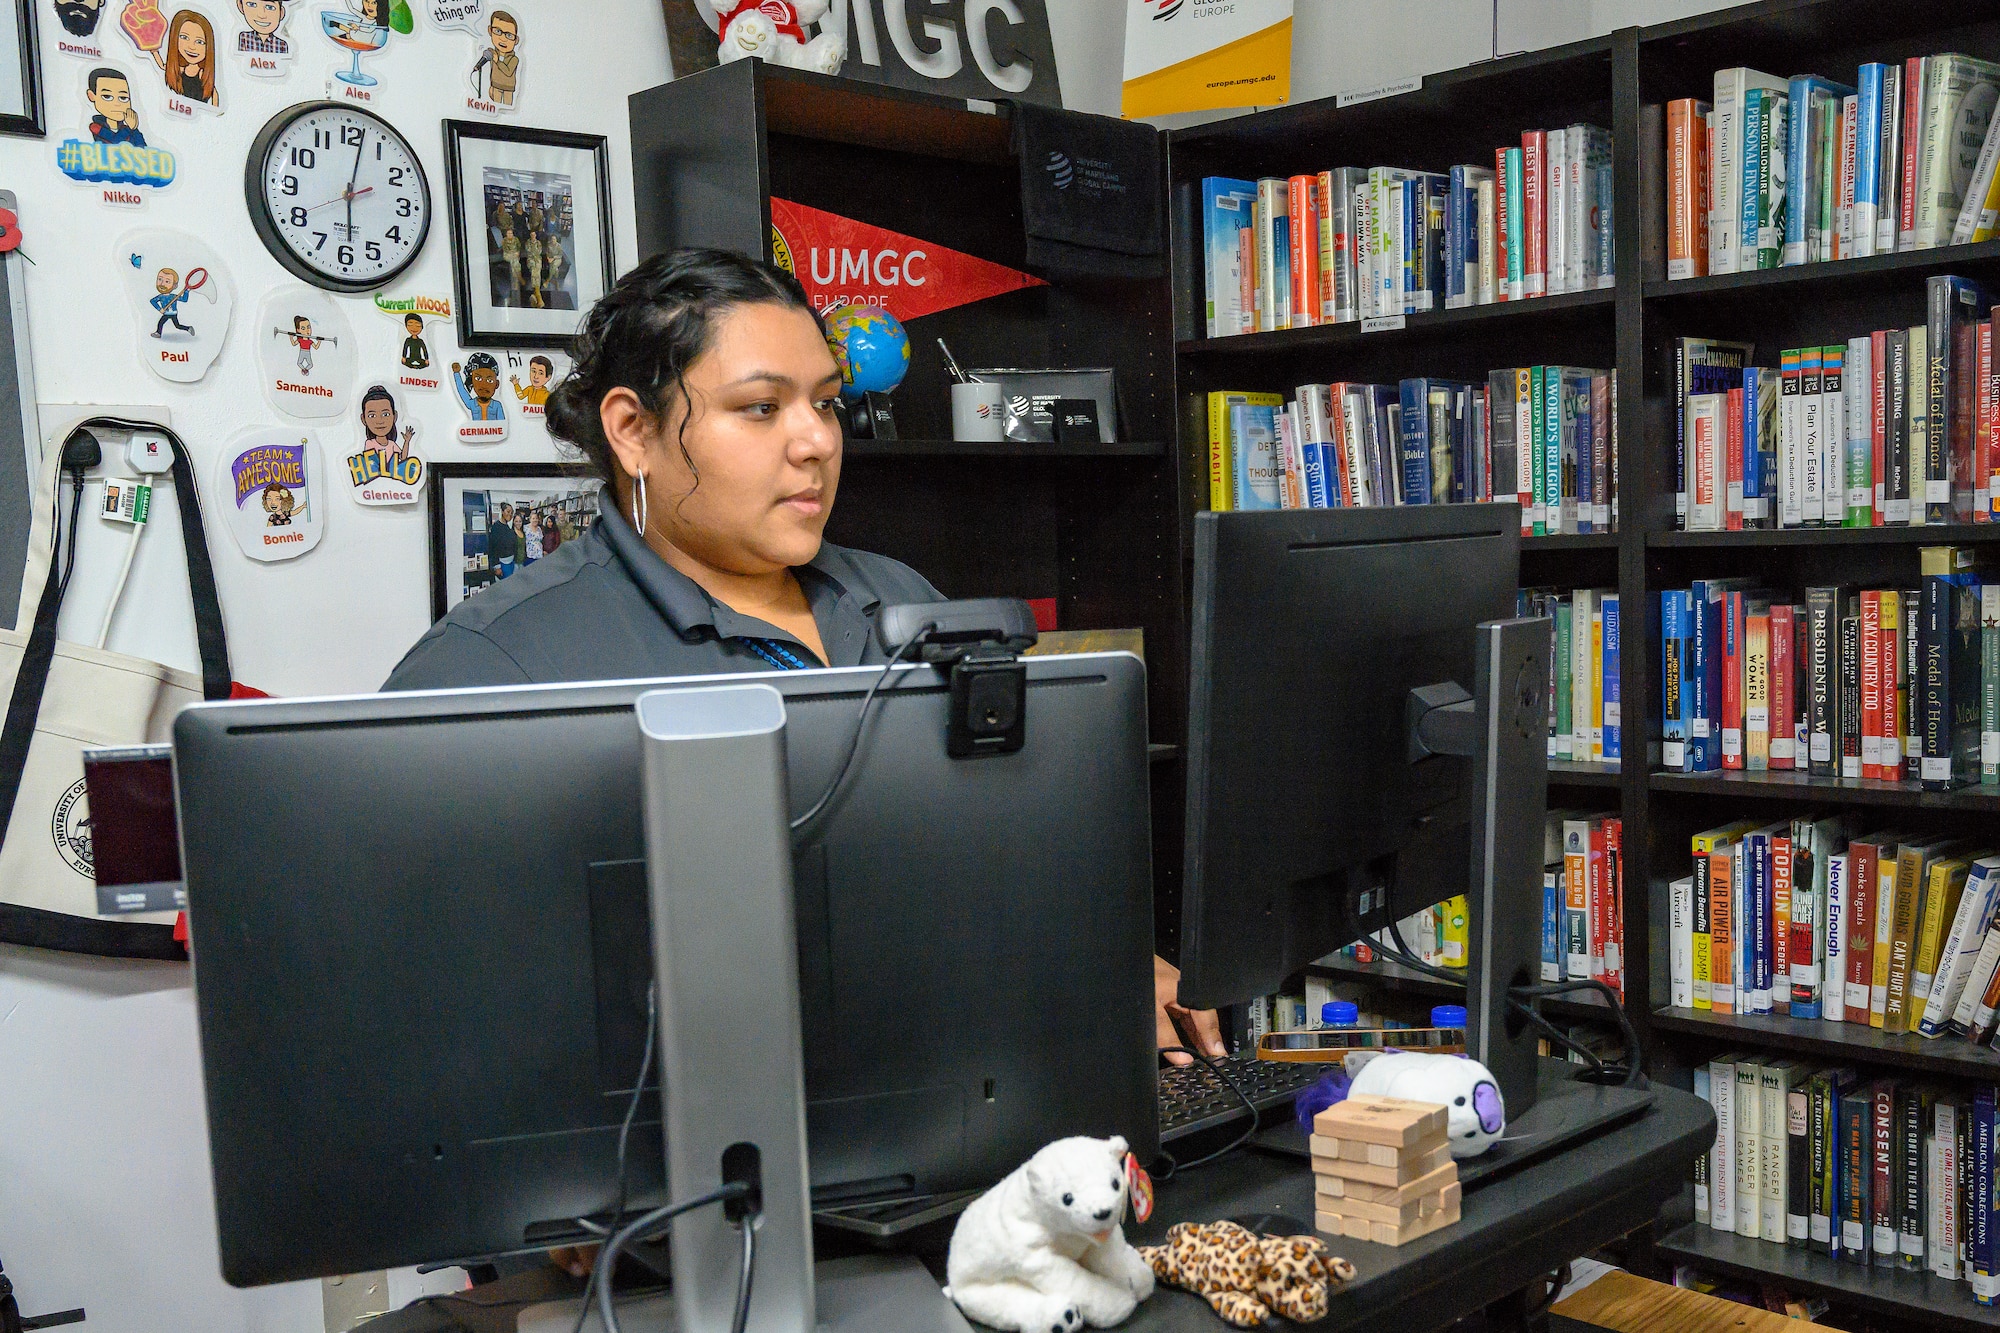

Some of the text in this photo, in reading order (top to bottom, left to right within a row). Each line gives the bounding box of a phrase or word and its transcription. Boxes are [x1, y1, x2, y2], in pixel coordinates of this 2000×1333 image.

[434, 8, 464, 20] thing
[1194, 5, 1235, 18] EUROPE
[59, 42, 101, 57] Dominic
[250, 58, 276, 70] Alex
[1206, 75, 1275, 88] europe.umgc.edu
[1355, 89, 1381, 99] Philosophy
[1387, 82, 1414, 93] Psychology
[346, 87, 370, 101] Alee
[169, 99, 192, 115] Lisa
[467, 97, 495, 114] Kevin
[1883, 78, 1894, 138] Redemption
[314, 129, 330, 149] 11
[340, 126, 362, 145] 12
[1849, 126, 1855, 135] A
[60, 144, 174, 179] #BLESSED
[291, 148, 314, 169] 10
[1760, 114, 1768, 194] FRUGILLIONAIRE
[1922, 106, 1938, 203] The Next Millionaire Next
[388, 168, 404, 187] 2
[1526, 146, 1535, 199] BEST SELF
[1744, 107, 1759, 229] PERSONAL FINANCE IN
[1975, 149, 1993, 185] Planning
[282, 175, 299, 196] 9
[104, 192, 141, 204] Nikko
[396, 198, 411, 217] 3
[291, 207, 307, 228] 8
[312, 232, 327, 250] 7
[385, 226, 401, 243] 4
[1371, 207, 1379, 255] HABITS
[338, 246, 354, 265] 6
[365, 241, 381, 260] 5
[772, 232, 789, 268] YLAN
[811, 248, 926, 286] UMGC
[375, 292, 450, 316] Current Mood
[161, 351, 189, 364] Paul
[507, 351, 523, 369] hi
[1894, 344, 1902, 384] HANGAR
[276, 380, 333, 398] Samantha
[400, 376, 438, 388] LINDSEY
[1533, 383, 1541, 424] WORLD'S
[1547, 384, 1558, 442] WORLD'S
[1930, 357, 1944, 469] Medal of Honor
[460, 426, 503, 436] GERMAINE
[250, 449, 283, 462] TEAM
[1404, 451, 1424, 460] Bible
[1595, 438, 1604, 467] Christ
[1704, 418, 1712, 478] REVOLUTIONARY
[1808, 405, 1816, 492] Plan Your Estate
[349, 451, 422, 487] HELLO
[1212, 442, 1220, 483] HABIT
[1306, 463, 1319, 481] 8th
[238, 461, 302, 496] AWESOME
[142, 491, 150, 518] CAUTION
[362, 490, 412, 500] Gleniece
[263, 532, 304, 545] Bonnie
[1815, 610, 1826, 702] PRESIDENTS
[1864, 600, 1877, 709] IT'S MY COUNTRY TOO
[1928, 645, 1940, 754] Medal of Honor
[1817, 707, 1823, 716] OF
[57, 783, 85, 847] UNIVERSITY OF
[73, 860, 96, 876] EURO
[1574, 858, 1582, 868] The
[1574, 870, 1582, 885] World
[1775, 844, 1789, 912] TOPGUN
[1574, 894, 1582, 904] Flat
[1698, 858, 1706, 931] Veterans Benefits
[1793, 895, 1812, 904] BLIND
[1855, 858, 1866, 925] Smoke Signals
[1674, 888, 1682, 928] Aircraft
[1713, 878, 1728, 944] AIR POWER
[1792, 914, 1812, 923] BLUFF
[1793, 905, 1812, 913] MAN'S
[1828, 861, 1841, 956] Never Enough
[1889, 859, 1914, 1014] DAVID GOGGINS CAN'T HURT ME
[1877, 1092, 1889, 1175] CONSENT
[1978, 1121, 1987, 1244] AMERICAN CORRECTIONS
